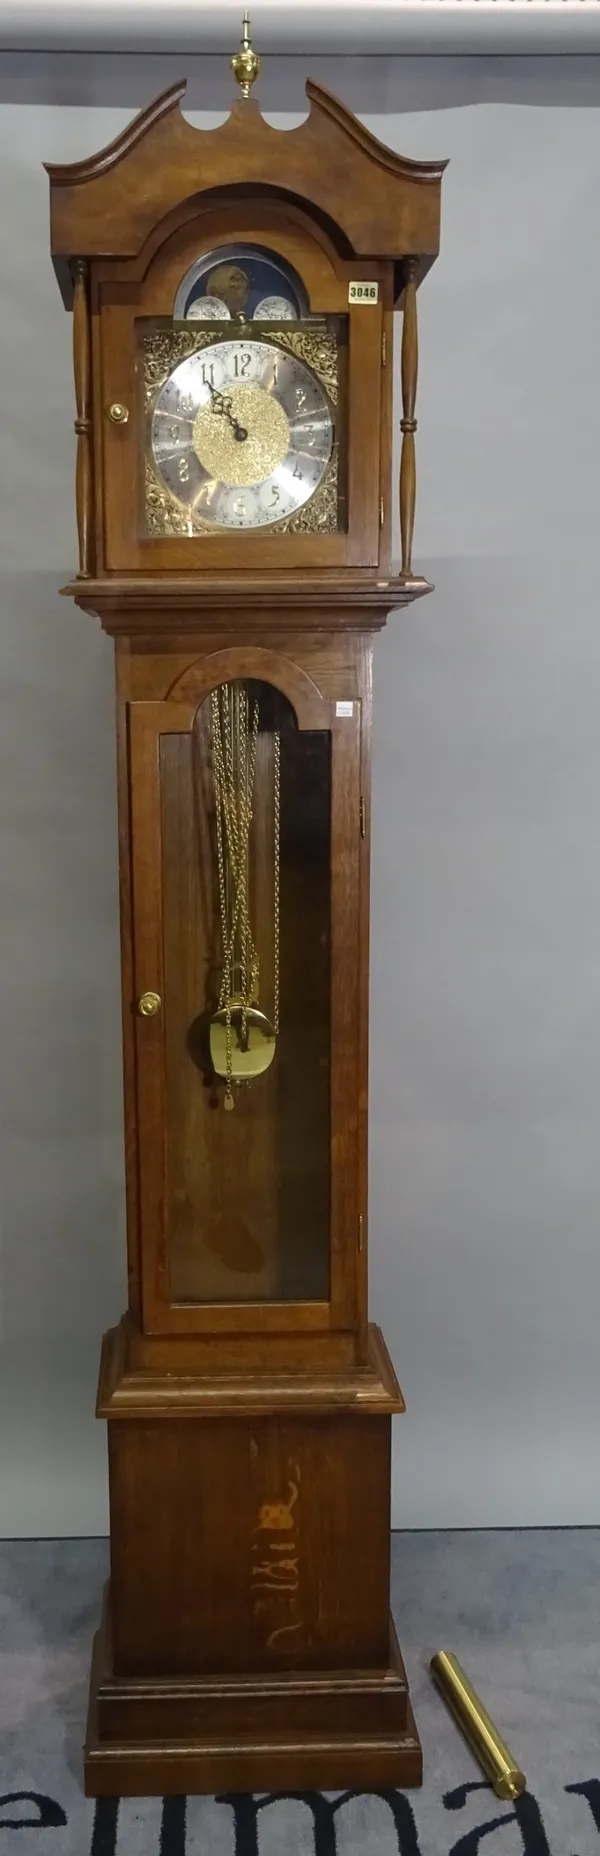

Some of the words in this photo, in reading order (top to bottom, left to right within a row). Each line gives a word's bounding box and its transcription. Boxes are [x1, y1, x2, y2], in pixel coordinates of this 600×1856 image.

[350, 287, 376, 298] 3046
[201, 363, 214, 386] 11
[233, 353, 252, 377] 12
[272, 364, 279, 386] 1
[295, 388, 307, 413] 2
[169, 424, 181, 445] 9
[303, 424, 316, 447] 3
[178, 458, 189, 482] 8
[292, 460, 304, 481] 4
[233, 494, 246, 517] 6
[268, 485, 280, 508] 5
